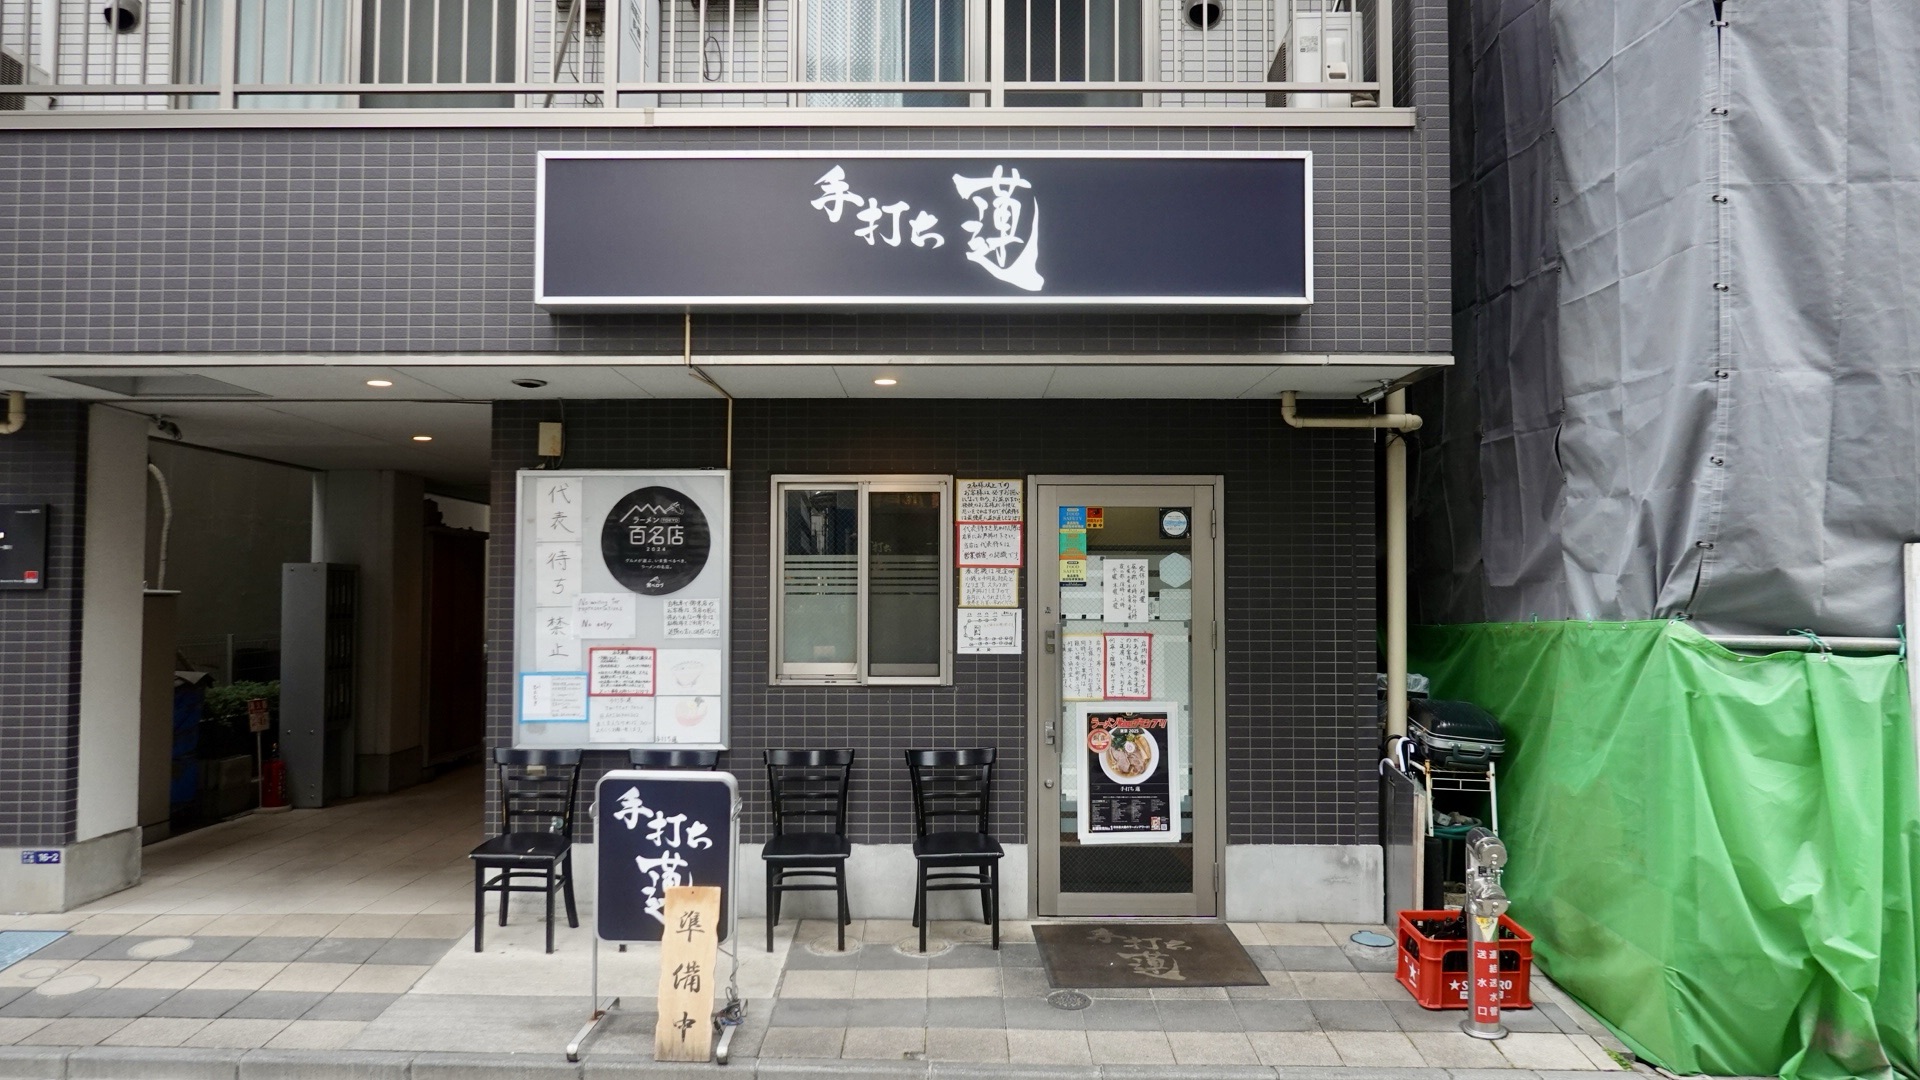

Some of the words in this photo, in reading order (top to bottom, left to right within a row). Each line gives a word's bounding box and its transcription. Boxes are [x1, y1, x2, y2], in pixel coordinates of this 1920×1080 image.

[628, 525, 684, 545] 百名店
[581, 619, 592, 627] No
[596, 620, 614, 630] entry
[613, 786, 713, 850] 手打ち
[672, 910, 705, 1043] 準備中
[1477, 950, 1488, 1016] 送水口
